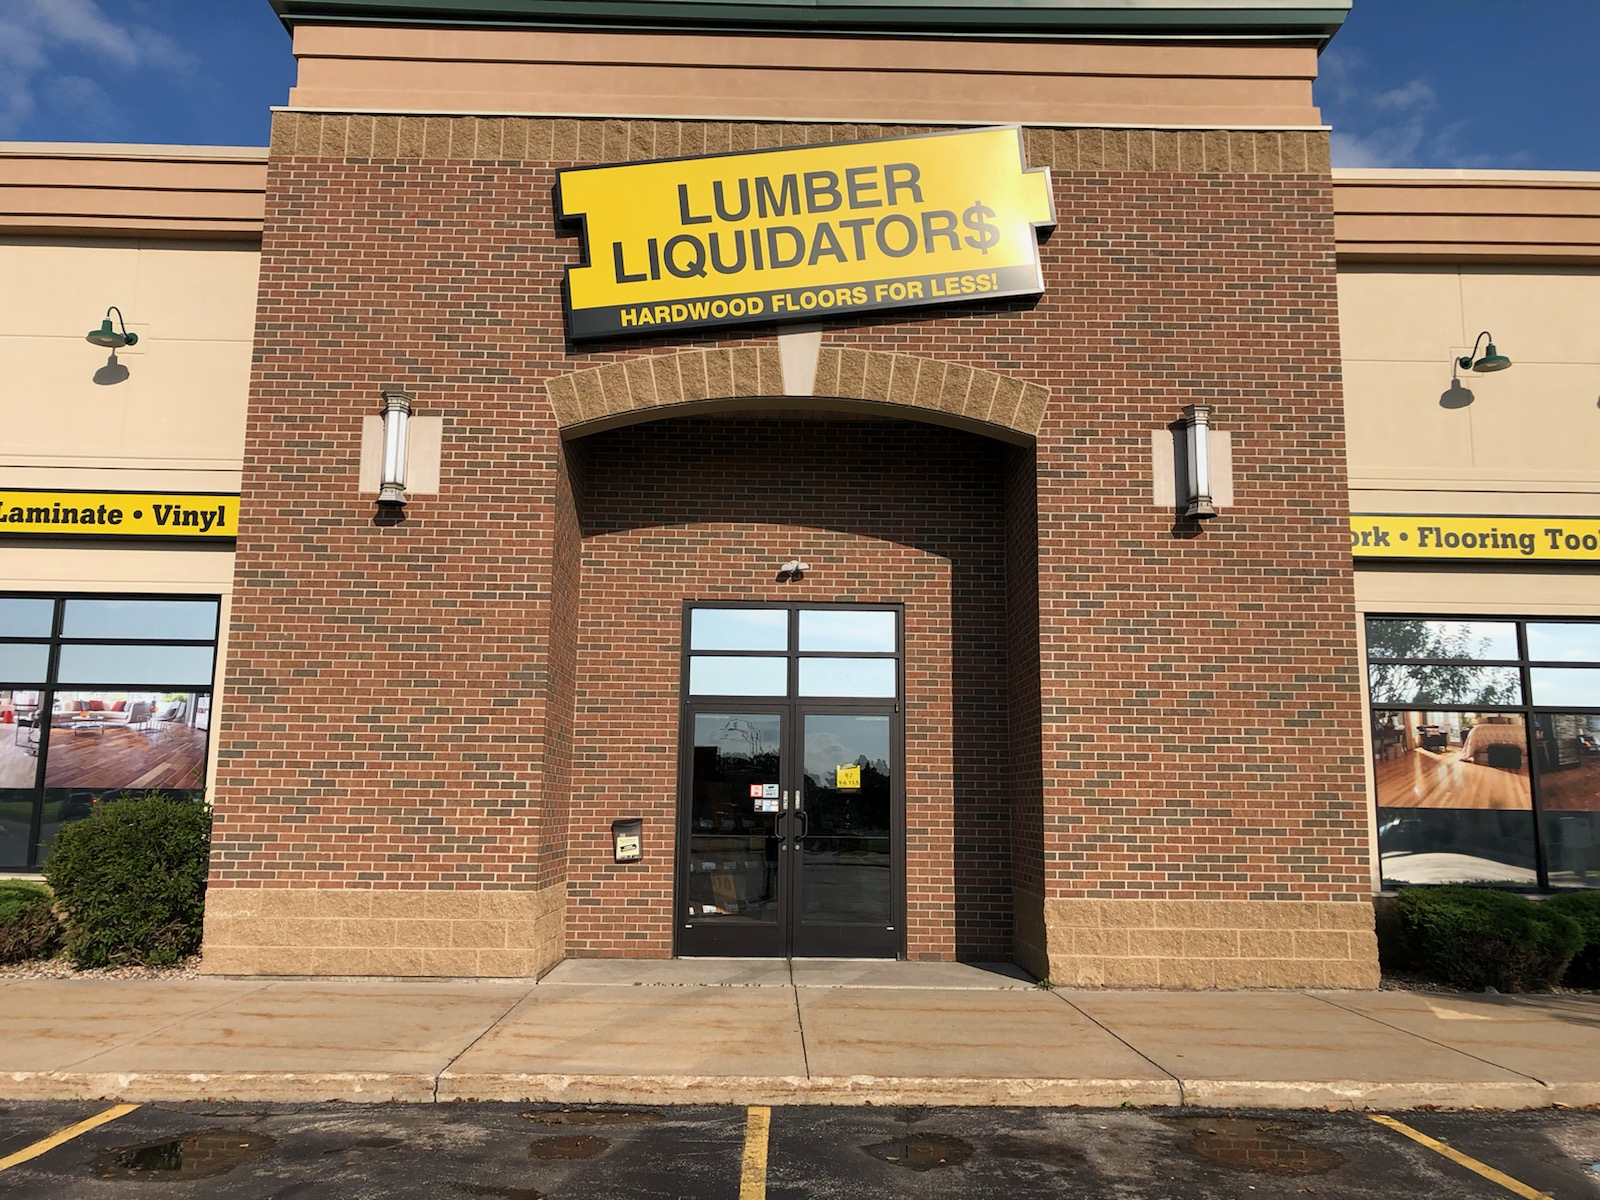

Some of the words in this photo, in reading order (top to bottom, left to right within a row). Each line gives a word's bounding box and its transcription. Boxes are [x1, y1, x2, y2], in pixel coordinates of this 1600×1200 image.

[677, 162, 925, 226] LUMBER
[612, 200, 1001, 284] LIQUIDATOR$
[620, 297, 764, 328] HARDWOOD
[771, 287, 868, 314] FLOORS
[874, 281, 924, 302] FOR
[930, 273, 999, 296] LESS!
[152, 505, 226, 532] Vinyl
[1417, 526, 1535, 556] Flooring
[1544, 528, 1600, 550] Too
